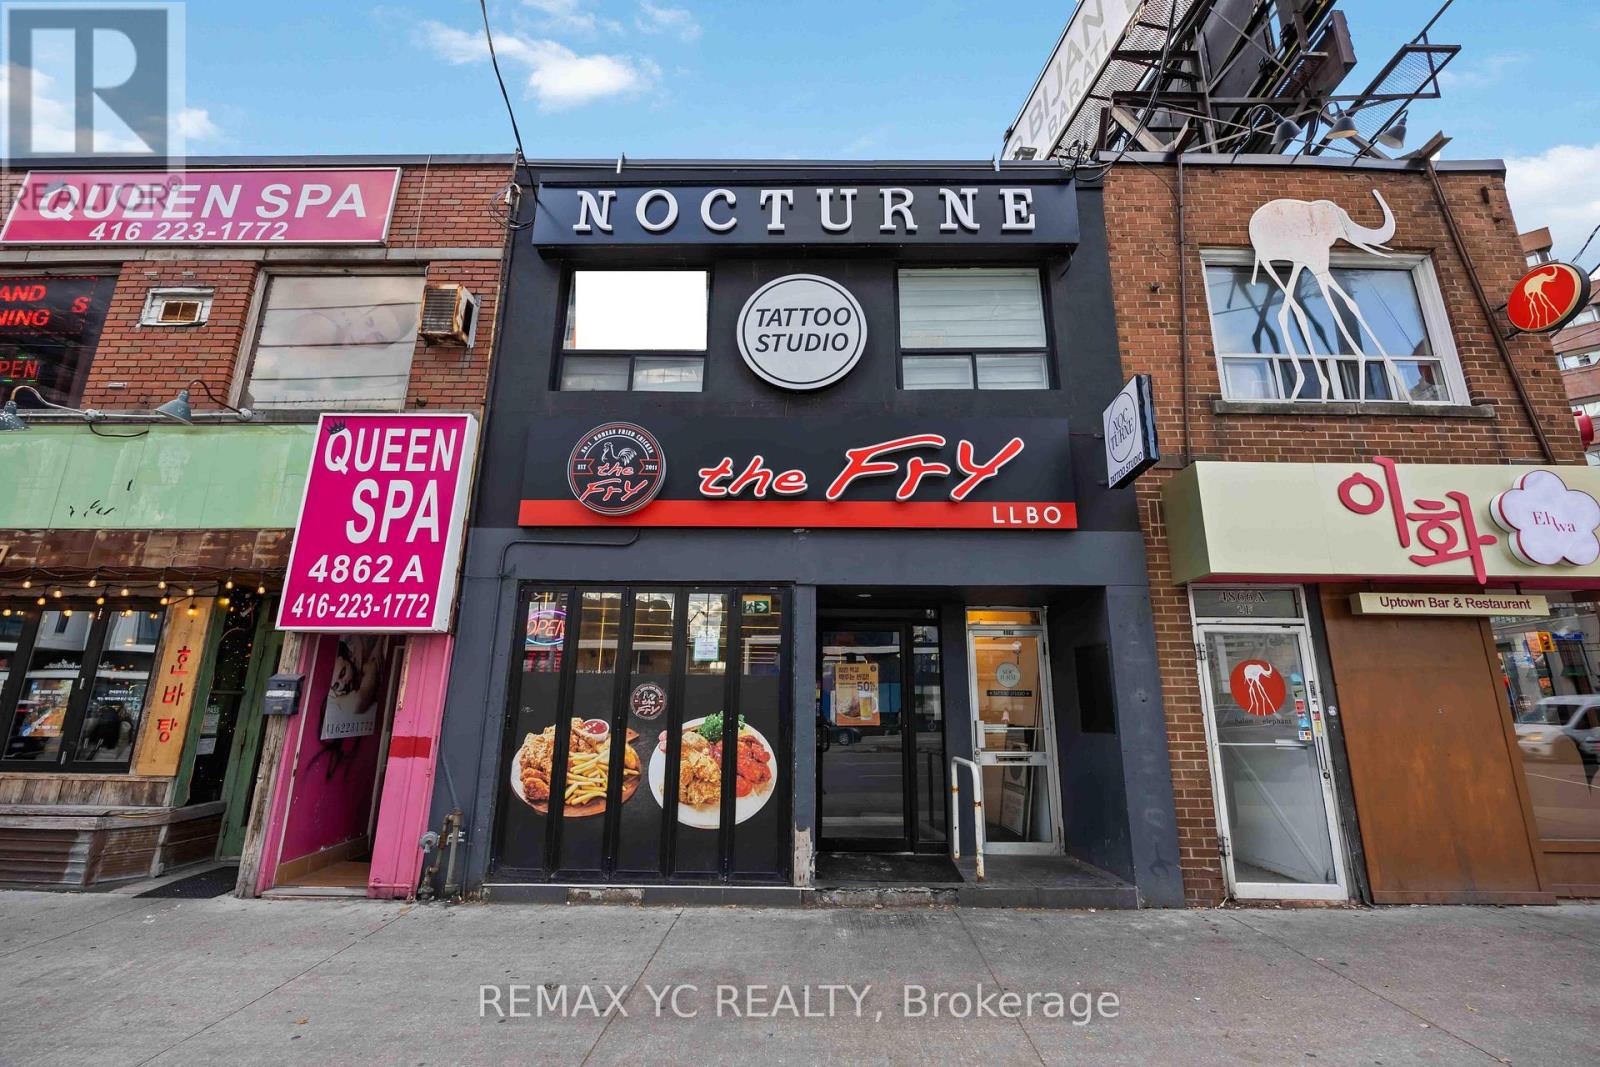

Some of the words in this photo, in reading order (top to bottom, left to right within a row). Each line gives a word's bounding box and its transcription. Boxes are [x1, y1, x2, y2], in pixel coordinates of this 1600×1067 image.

[38, 184, 241, 222] QUEEN
[256, 183, 367, 219] SPA
[572, 188, 1037, 232] NOCTURNE
[88, 221, 143, 240] 416
[151, 221, 289, 240] 223-1772
[756, 307, 852, 327] TATTOO
[755, 332, 849, 353] STUDIO
[324, 427, 457, 475] QUEEN
[592, 428, 616, 442] KOREAN
[617, 428, 636, 437] FRIED
[635, 433, 655, 455] CHICKEN
[597, 462, 635, 477] the
[699, 455, 809, 499] the
[1110, 466, 1126, 486] TATTOO
[1125, 451, 1143, 475] STUDIO
[345, 478, 440, 544] SPA
[992, 506, 1062, 525] LLBO
[1337, 455, 1498, 585] 이화
[1532, 511, 1577, 533] Ehwa
[308, 554, 394, 584] 4862
[398, 554, 424, 583] A
[291, 593, 430, 619] 416-223-1772
[1379, 596, 1426, 609] Uptown
[1428, 597, 1450, 608] Bar
[1453, 597, 1463, 608] &
[1465, 598, 1533, 610] Restaurant
